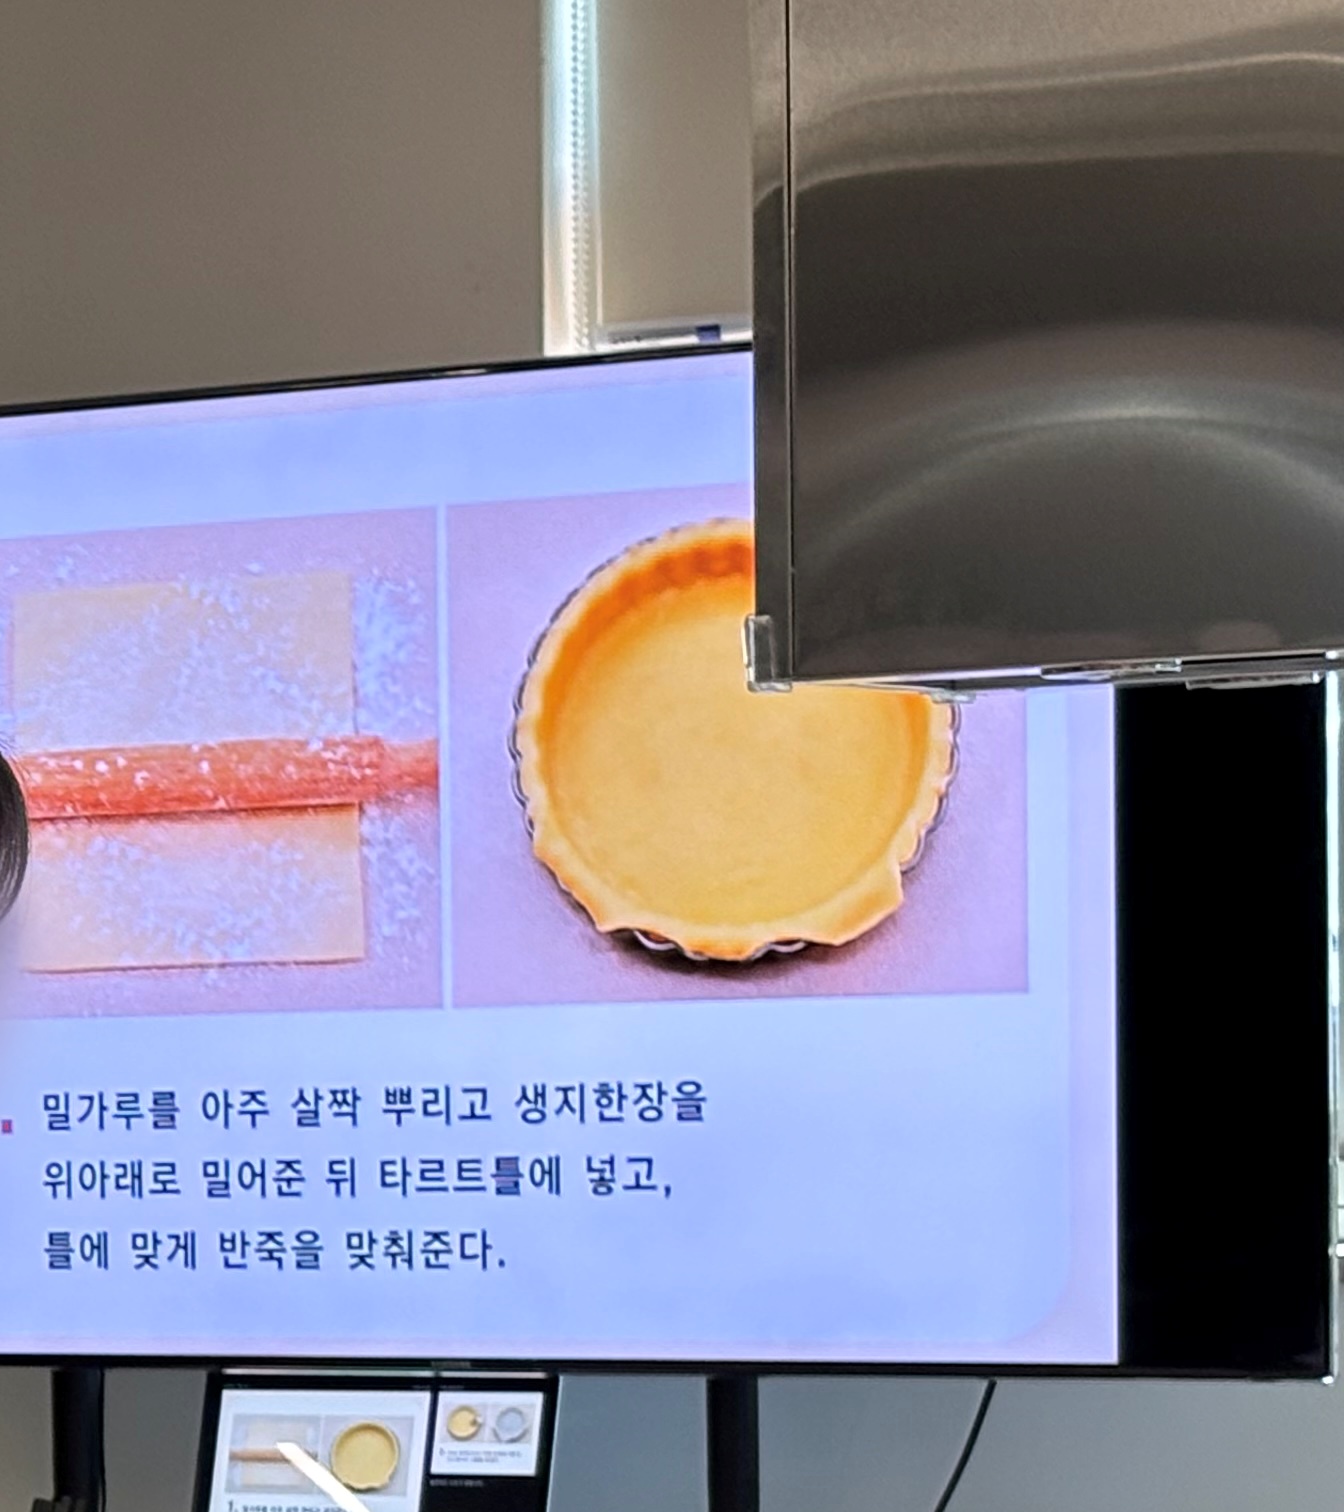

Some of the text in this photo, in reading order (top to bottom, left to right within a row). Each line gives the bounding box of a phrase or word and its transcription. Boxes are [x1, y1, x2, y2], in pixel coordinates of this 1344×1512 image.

[43, 1080, 707, 1131] 밀가루를 아주 살짝 뿌리고 생지한장을
[43, 1154, 672, 1199] 위아래로 밀어준 뒤 타르트틀에 넣고,
[44, 1229, 506, 1271] 틀에 맞게 반죽을 맞춰준다.
